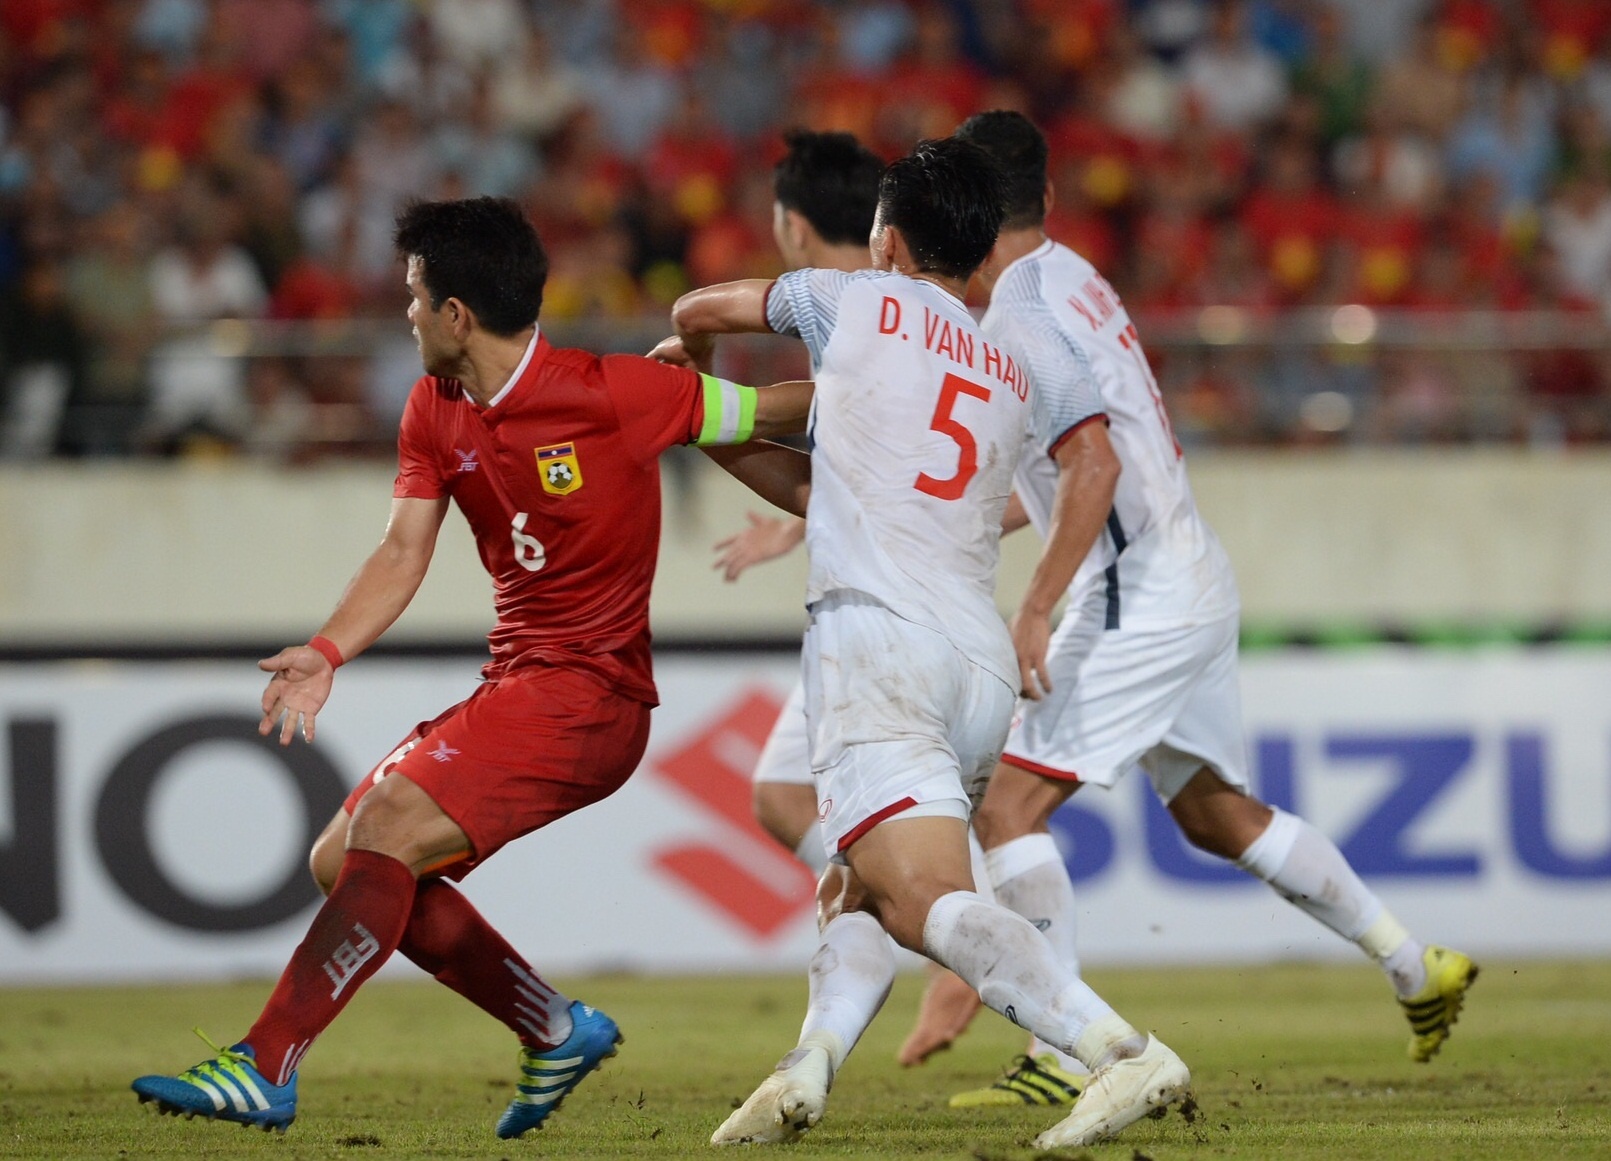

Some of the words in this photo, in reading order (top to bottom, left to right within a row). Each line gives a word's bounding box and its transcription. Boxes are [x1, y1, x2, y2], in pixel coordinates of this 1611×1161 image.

[879, 295, 909, 341] D.
[924, 306, 974, 369] VAN
[983, 341, 1029, 403] HAU
[913, 371, 991, 501] 5
[511, 511, 546, 572] 6
[322, 922, 380, 1001] FBT
